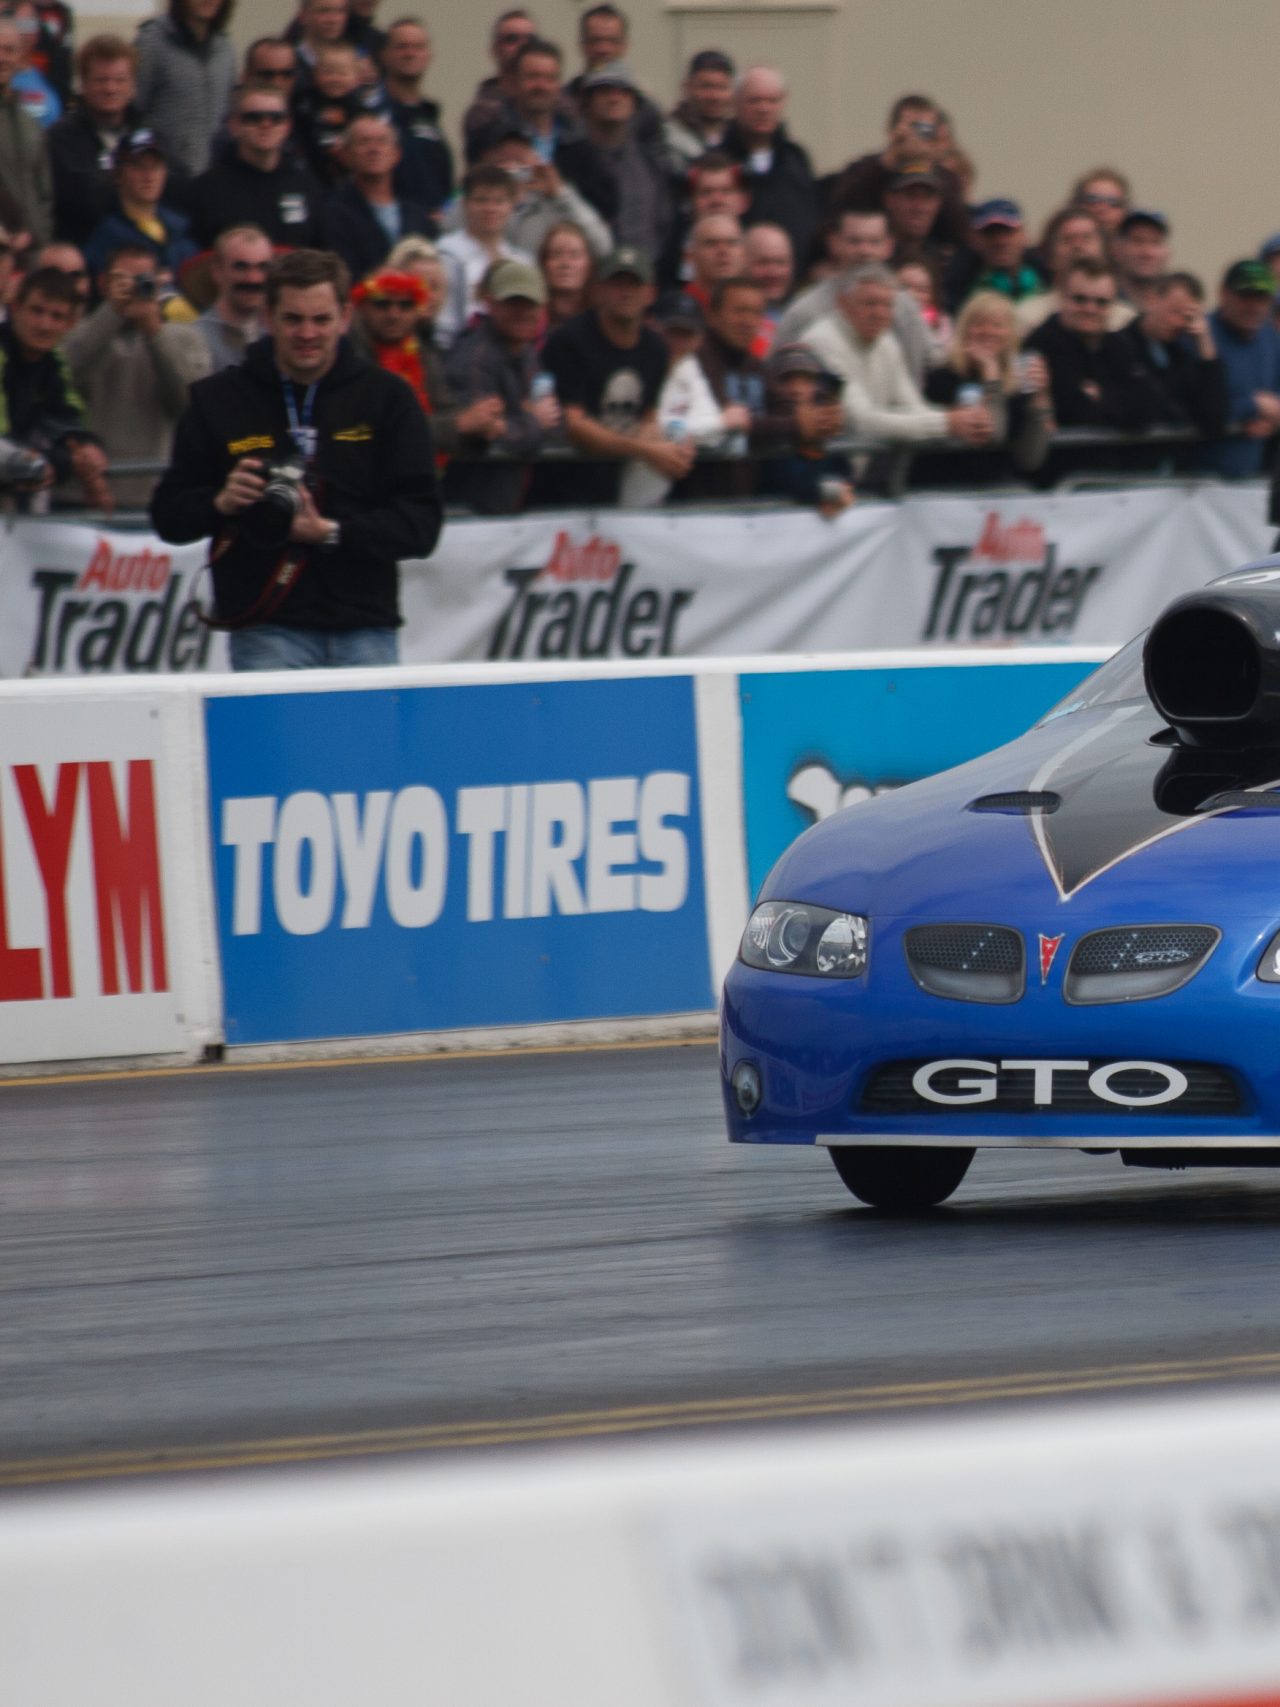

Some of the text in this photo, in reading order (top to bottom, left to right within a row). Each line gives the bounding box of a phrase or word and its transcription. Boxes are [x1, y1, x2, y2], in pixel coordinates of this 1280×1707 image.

[76, 537, 172, 592] Auto
[540, 530, 623, 584] Auto
[921, 543, 1104, 641] Trader
[485, 563, 697, 661] Trader
[223, 772, 690, 935] TOYO TIRES
[912, 1059, 1188, 1106] GTO
